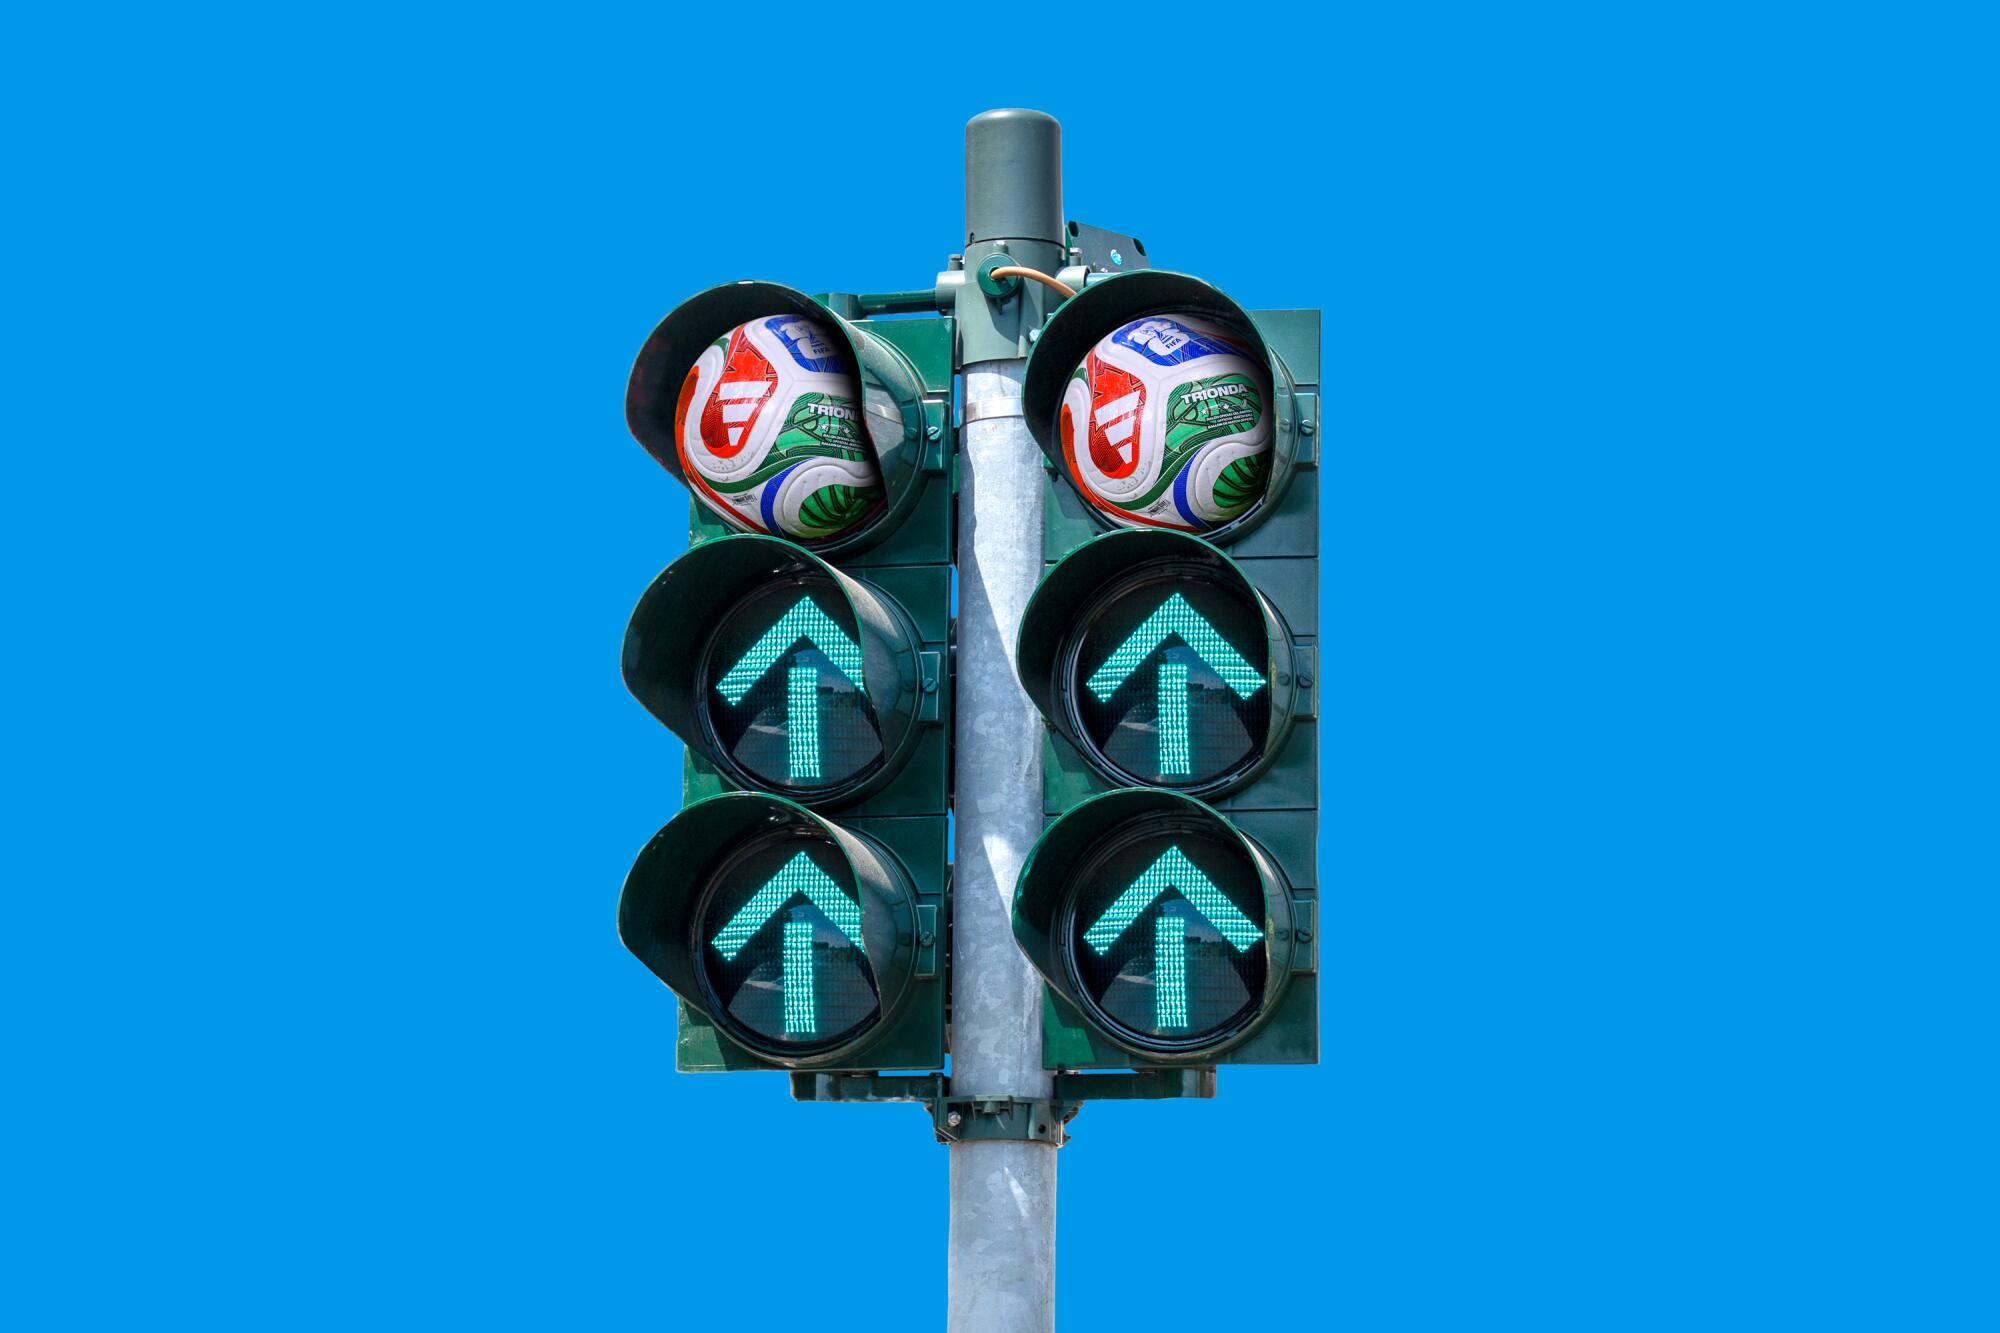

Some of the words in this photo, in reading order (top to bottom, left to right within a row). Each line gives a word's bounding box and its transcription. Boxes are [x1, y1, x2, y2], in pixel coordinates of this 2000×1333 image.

[1165, 338, 1182, 349] FIFA
[1180, 383, 1248, 404] TRIONDA
[807, 403, 857, 420] TRION
